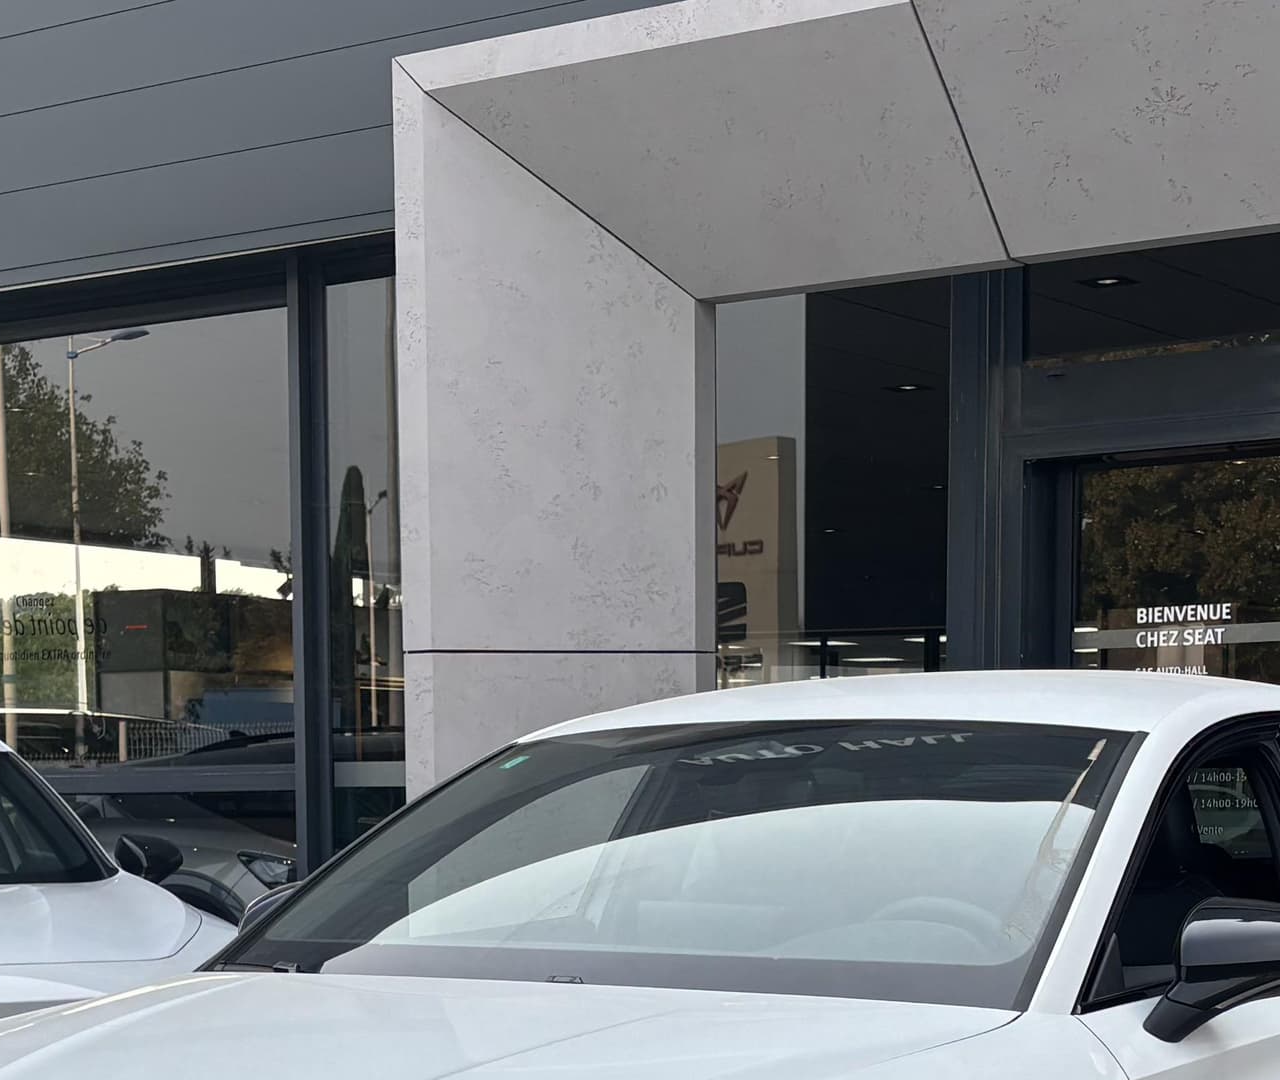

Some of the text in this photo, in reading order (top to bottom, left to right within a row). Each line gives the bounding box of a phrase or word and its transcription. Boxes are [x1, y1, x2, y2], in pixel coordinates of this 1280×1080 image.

[16, 596, 54, 609] Changez
[1136, 603, 1232, 624] BIENVENUE
[1136, 628, 1225, 648] CHEZ SEAT
[41, 649, 69, 661] EXTRA
